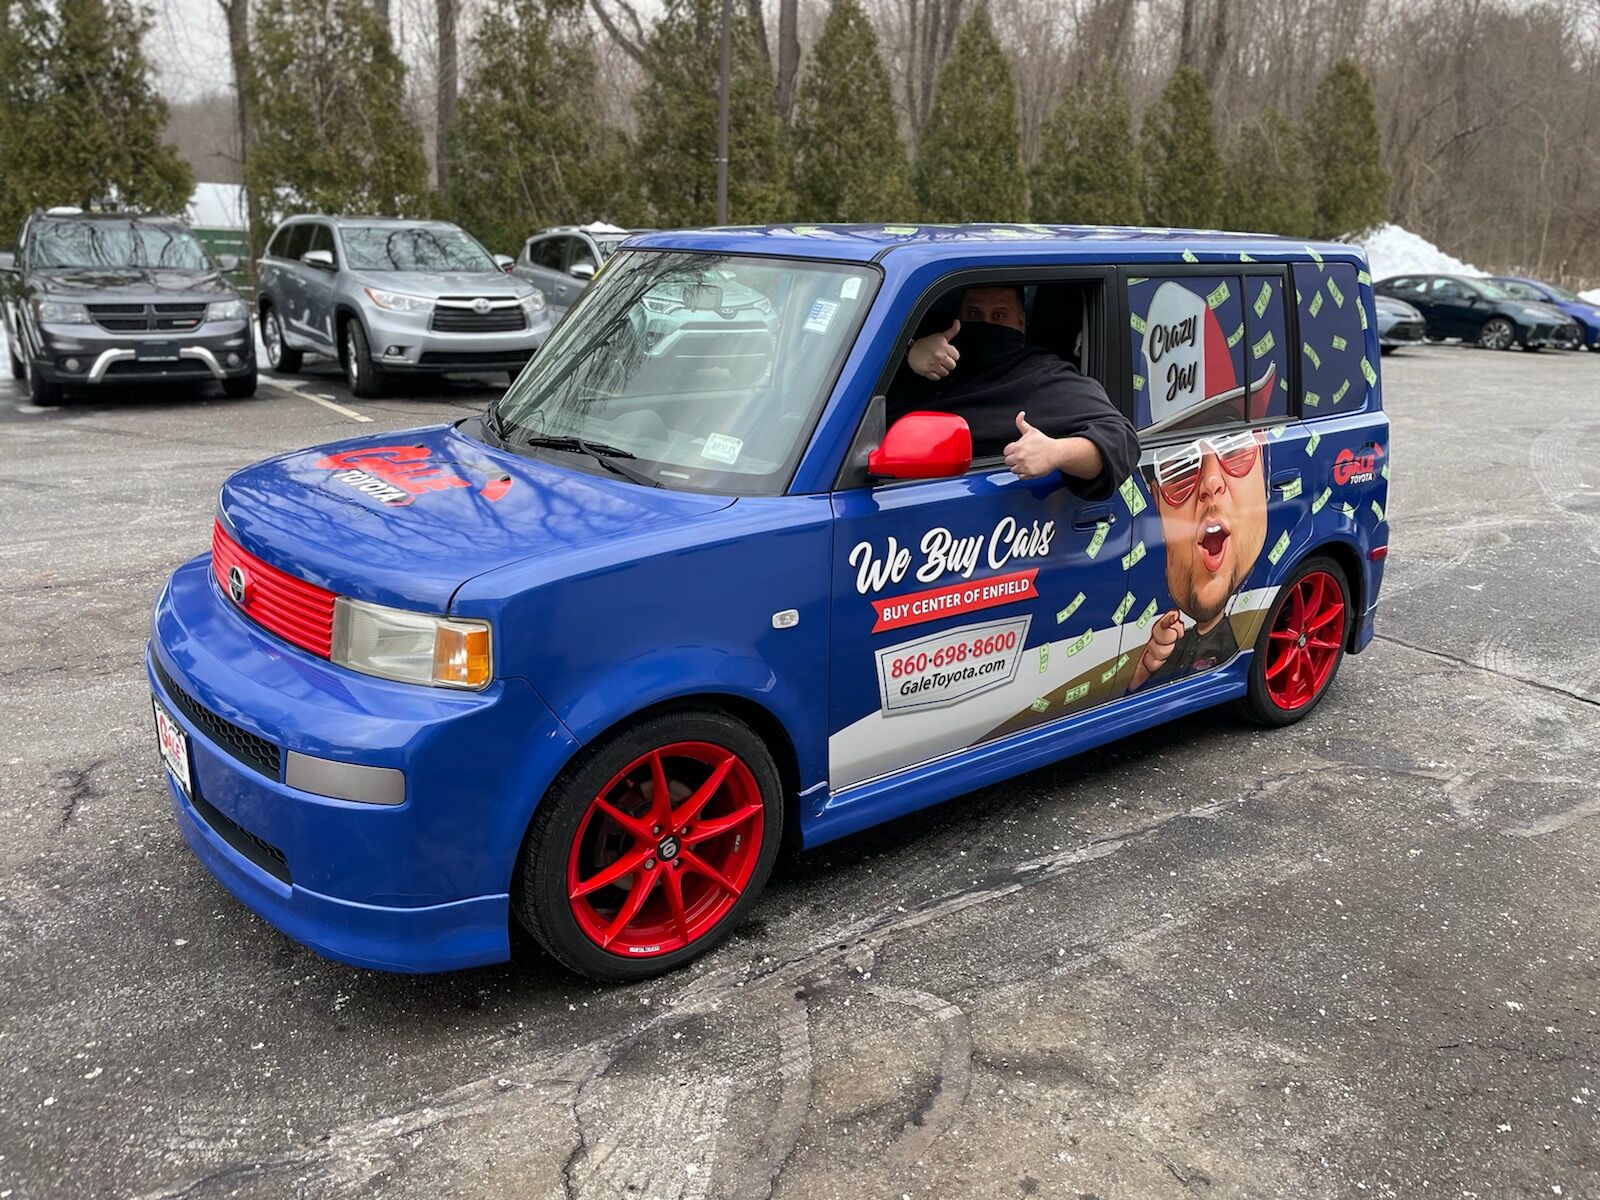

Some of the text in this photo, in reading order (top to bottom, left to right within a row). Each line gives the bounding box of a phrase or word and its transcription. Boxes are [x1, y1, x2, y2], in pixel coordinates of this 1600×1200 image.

[1149, 314, 1197, 363] Crazy
[1166, 361, 1197, 401] Jay
[333, 469, 409, 503] TOYOTA
[1350, 472, 1373, 484] TOYOTA
[849, 516, 1056, 594] We Buy Cars
[883, 578, 1030, 622] BUY CENTER OF ENFIELD
[900, 658, 1005, 696] GaleToyota.com
